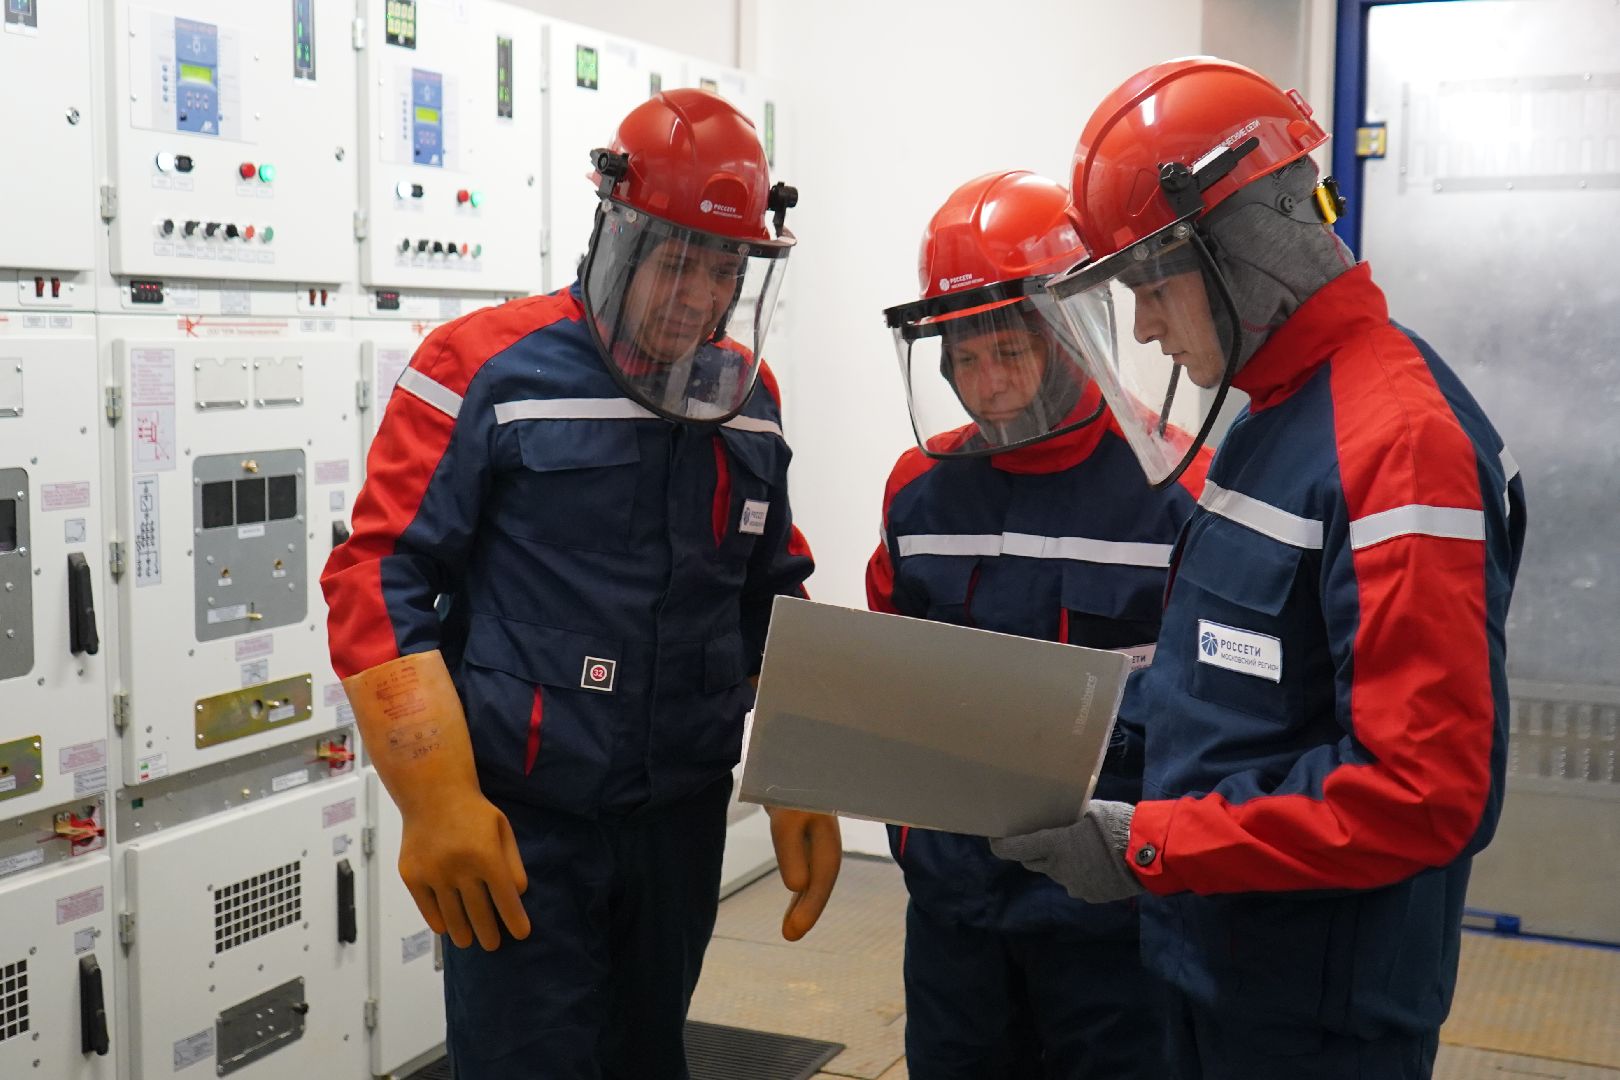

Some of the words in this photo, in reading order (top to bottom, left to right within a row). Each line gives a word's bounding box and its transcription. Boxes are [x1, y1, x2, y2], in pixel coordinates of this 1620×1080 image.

[1220, 639, 1261, 657] РОССЕТИ
[1221, 653, 1257, 667] МОСКОВСКИЙ
[1257, 660, 1279, 671] РЕГИОН
[593, 669, 604, 678] 32
